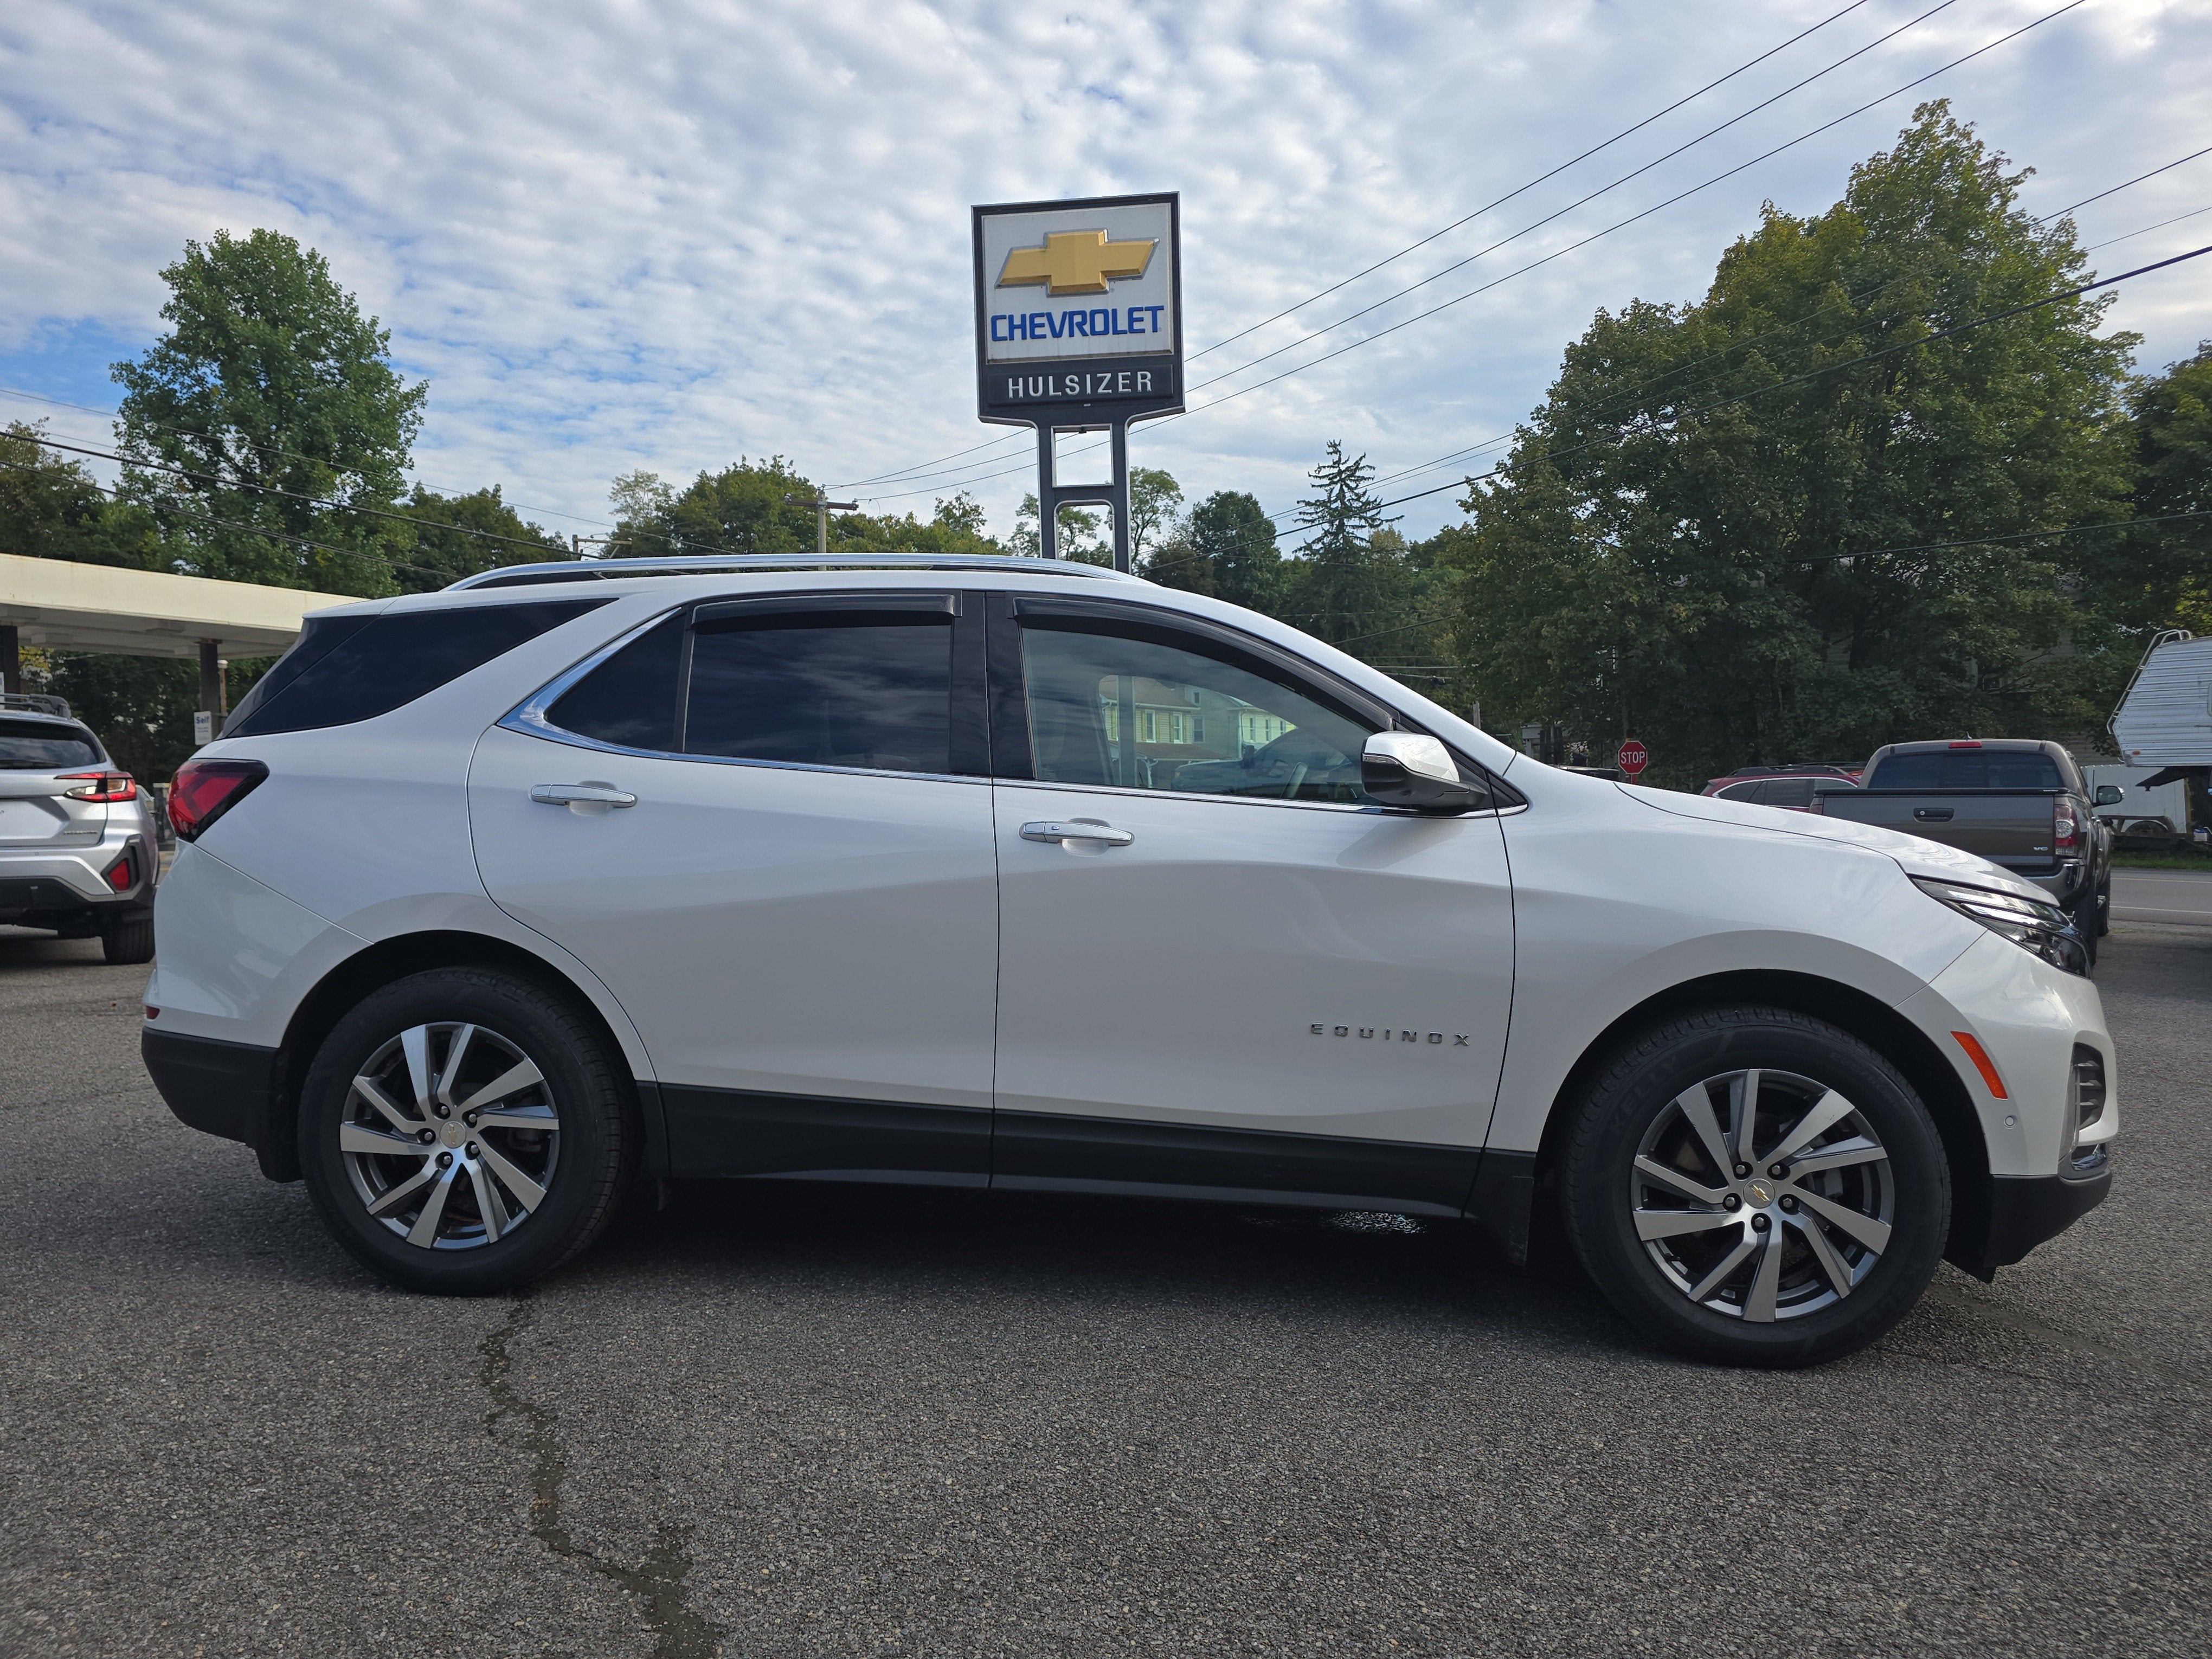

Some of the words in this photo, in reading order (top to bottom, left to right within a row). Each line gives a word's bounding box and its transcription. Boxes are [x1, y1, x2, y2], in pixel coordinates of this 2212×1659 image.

[991, 305, 1165, 342] CHEVROLET
[1008, 371, 1153, 399] HULSIZER
[1621, 751, 1645, 764] STOP
[1310, 1022, 1470, 1046] EQUINOX
[1608, 1055, 1677, 1137] KELLY
